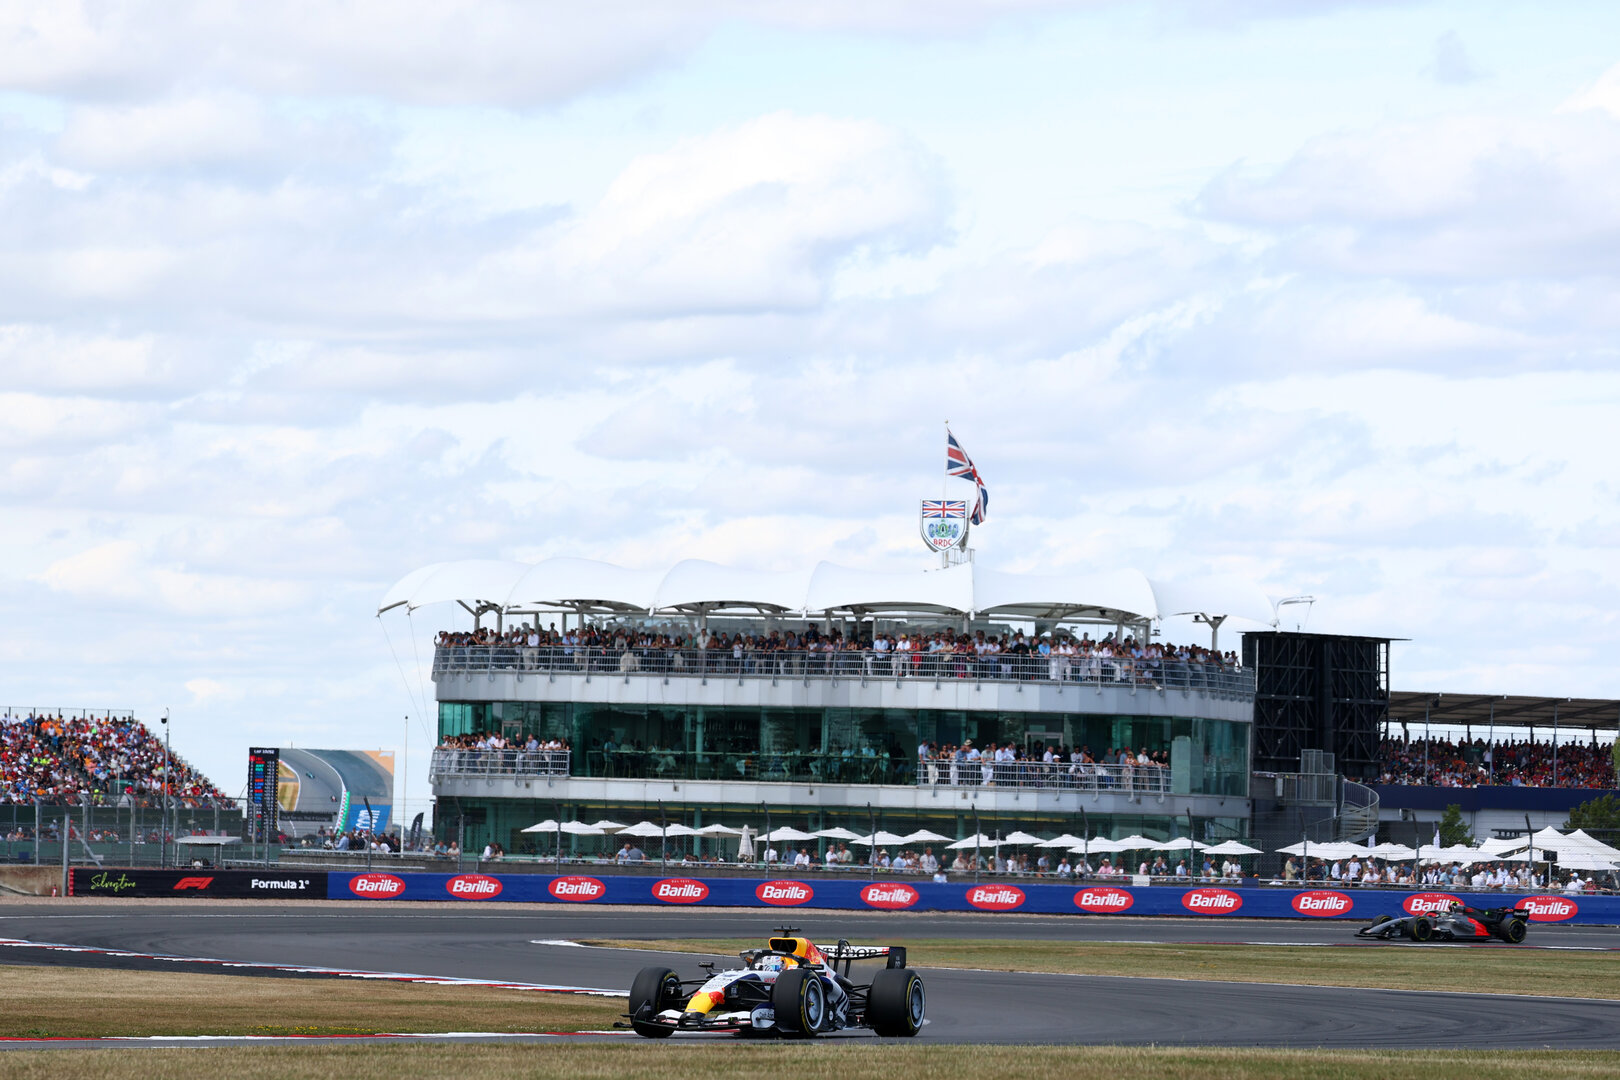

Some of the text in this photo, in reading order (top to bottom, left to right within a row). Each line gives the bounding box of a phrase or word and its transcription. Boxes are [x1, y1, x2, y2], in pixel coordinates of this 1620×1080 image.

[933, 538, 952, 547] BRDC
[251, 878, 297, 889] Formula
[356, 878, 398, 892] Barilla
[453, 880, 494, 893] Barilla
[555, 882, 598, 895] Barilla
[659, 884, 702, 897] Barilla
[762, 886, 806, 899] Barilla
[867, 888, 911, 903] Barilla
[973, 890, 1017, 904] Barilla
[1081, 893, 1125, 907] Barilla
[1189, 894, 1235, 908] Barilla
[1299, 896, 1345, 910] Barilla
[1410, 898, 1452, 912] Barill
[1523, 901, 1570, 915] Barilla
